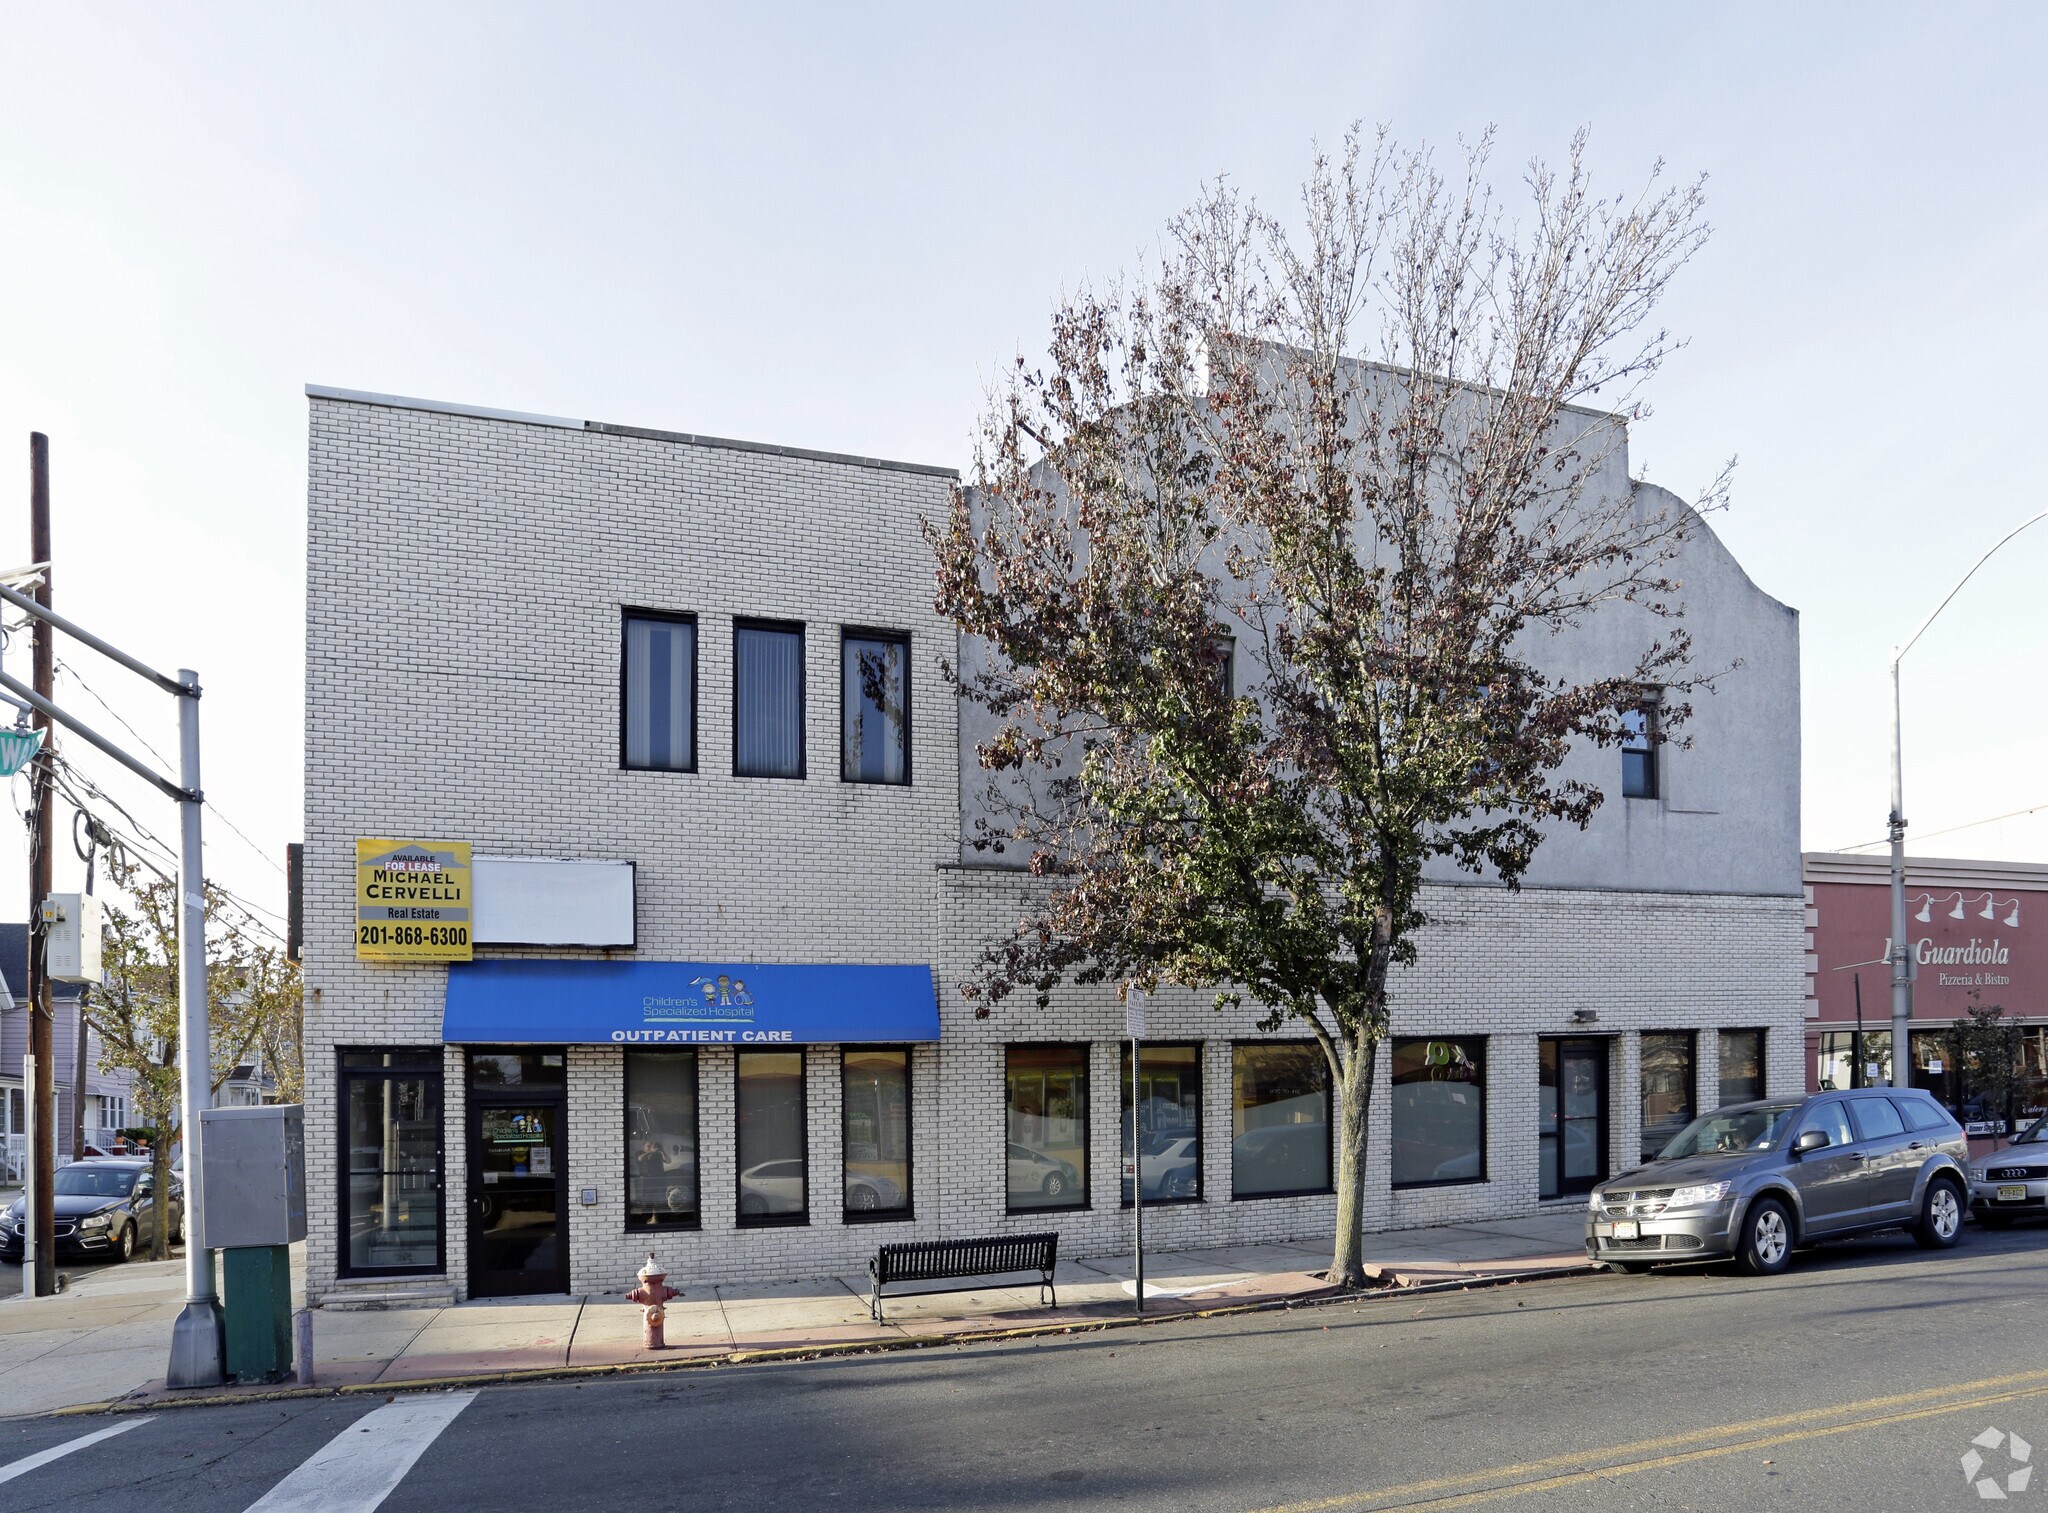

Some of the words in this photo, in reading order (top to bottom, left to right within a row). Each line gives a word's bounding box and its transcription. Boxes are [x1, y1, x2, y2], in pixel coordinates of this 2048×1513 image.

[385, 862, 405, 871] FOR
[408, 862, 440, 871] LEASE
[374, 870, 454, 884] MICHAEL
[366, 884, 460, 900] CERVELLI
[388, 908, 407, 919] Real
[411, 908, 440, 919] Estate
[361, 926, 467, 945] 201-868-6300
[1916, 938, 2009, 965] Guardiola
[1939, 972, 1973, 985] Pizzeria
[1975, 973, 1983, 985] &
[1985, 972, 2009, 985] Bistro
[643, 997, 697, 1006] Children's
[643, 1007, 706, 1017] Specialized
[709, 1007, 754, 1017] Hospital
[611, 1030, 736, 1041] OUTPATIENT
[742, 1031, 792, 1041] CARE
